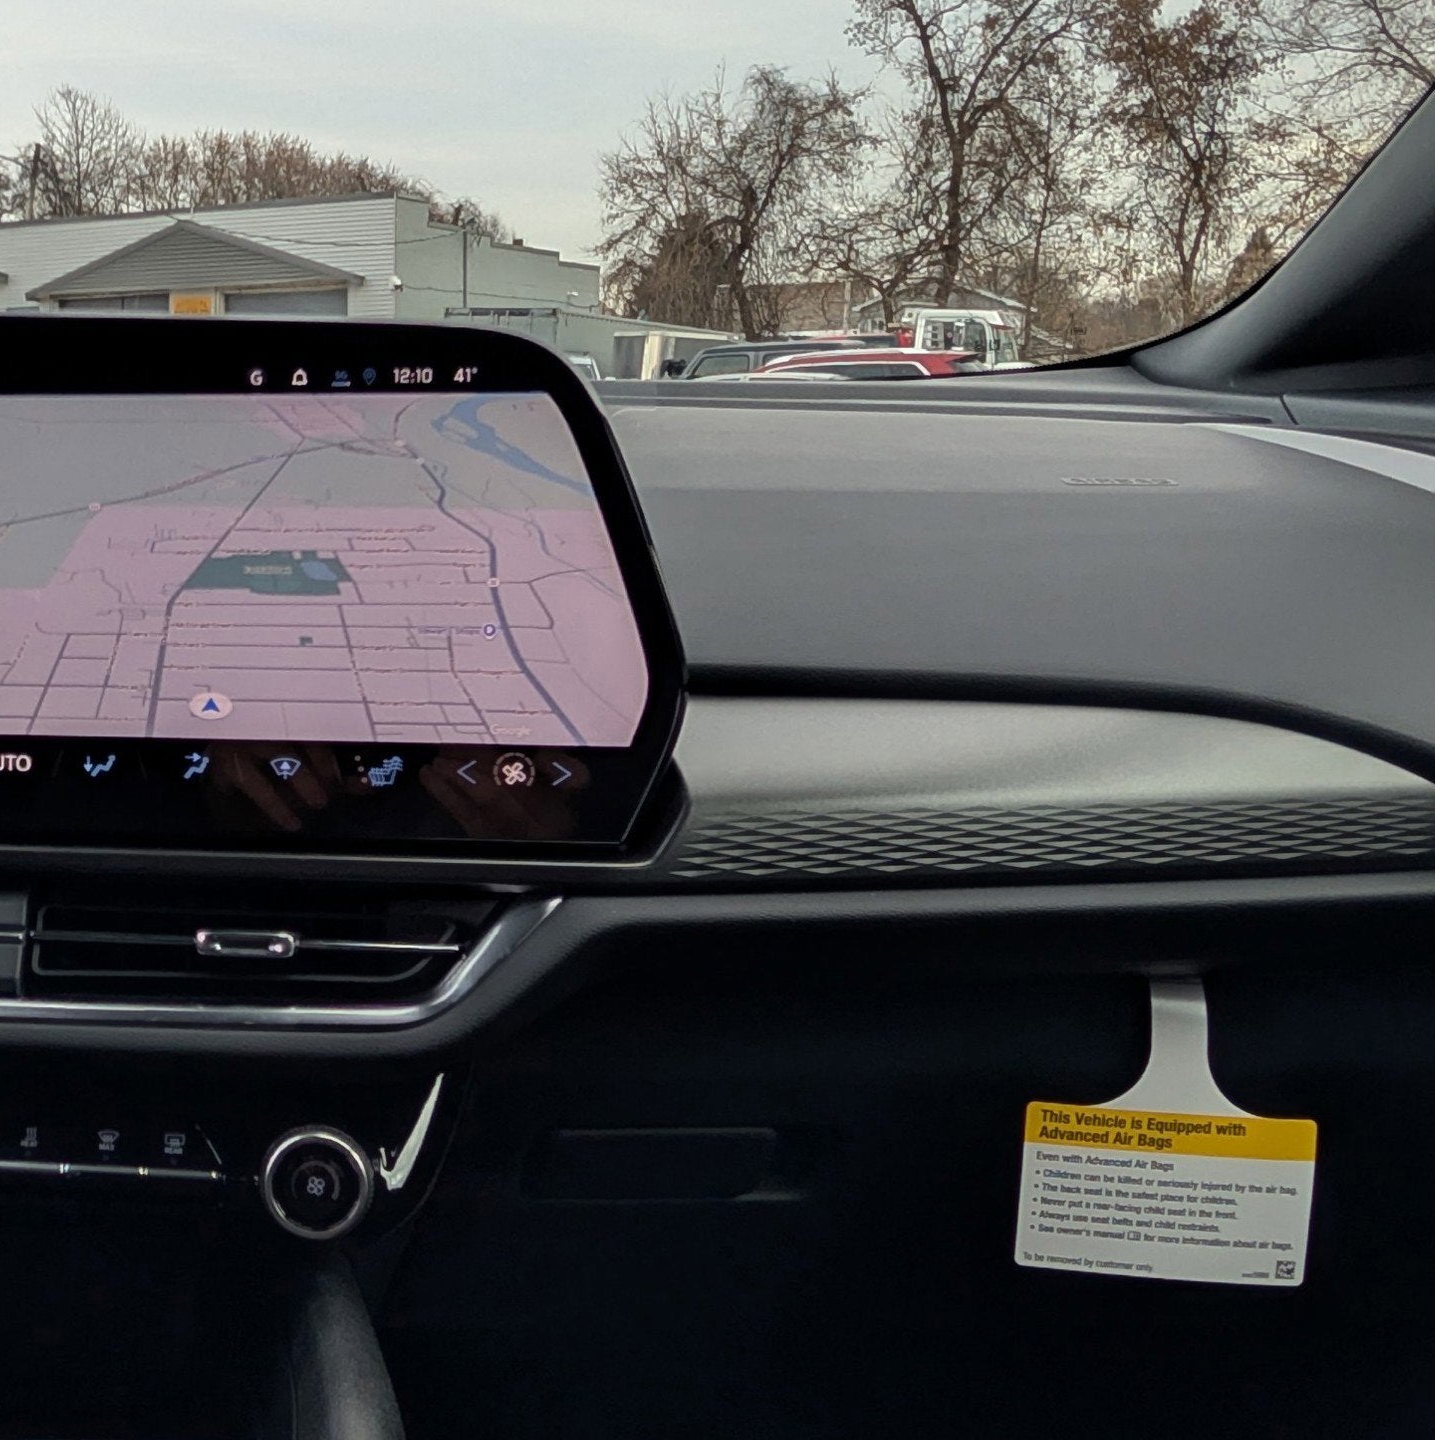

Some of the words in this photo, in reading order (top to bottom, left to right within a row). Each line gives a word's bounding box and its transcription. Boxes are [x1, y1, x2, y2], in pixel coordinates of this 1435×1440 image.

[392, 367, 433, 384] 12:10
[453, 366, 478, 383] 41°
[491, 724, 533, 737] Google
[1041, 1109, 1071, 1125] This
[1075, 1112, 1127, 1129] Vehicle
[1130, 1116, 1143, 1130] is
[1146, 1118, 1212, 1136] Equipped
[1216, 1123, 1246, 1137] with
[1039, 1126, 1110, 1144] Advanced
[1113, 1131, 1134, 1146] Air
[1137, 1133, 1173, 1150] Bags
[1036, 1151, 1060, 1161] Even
[1062, 1154, 1083, 1164] with
[1085, 1155, 1132, 1168] Advanced
[1134, 1159, 1149, 1170] Air
[1150, 1161, 1174, 1172] Bags
[1042, 1182, 1058, 1192] The
[1060, 1184, 1081, 1195] back
[1115, 1189, 1130, 1198] the
[1043, 1169, 1082, 1180] Children
[1083, 1173, 1101, 1182] can
[1103, 1174, 1115, 1183] be
[1235, 1183, 1246, 1194] by
[1248, 1184, 1263, 1194] the
[1265, 1185, 1278, 1194] air
[1040, 1196, 1067, 1207] Never
[1039, 1210, 1071, 1222] Always
[1038, 1224, 1055, 1233] See
[1023, 1251, 1033, 1261] To
[1034, 1253, 1045, 1262] be
[1083, 1257, 1094, 1268] by
